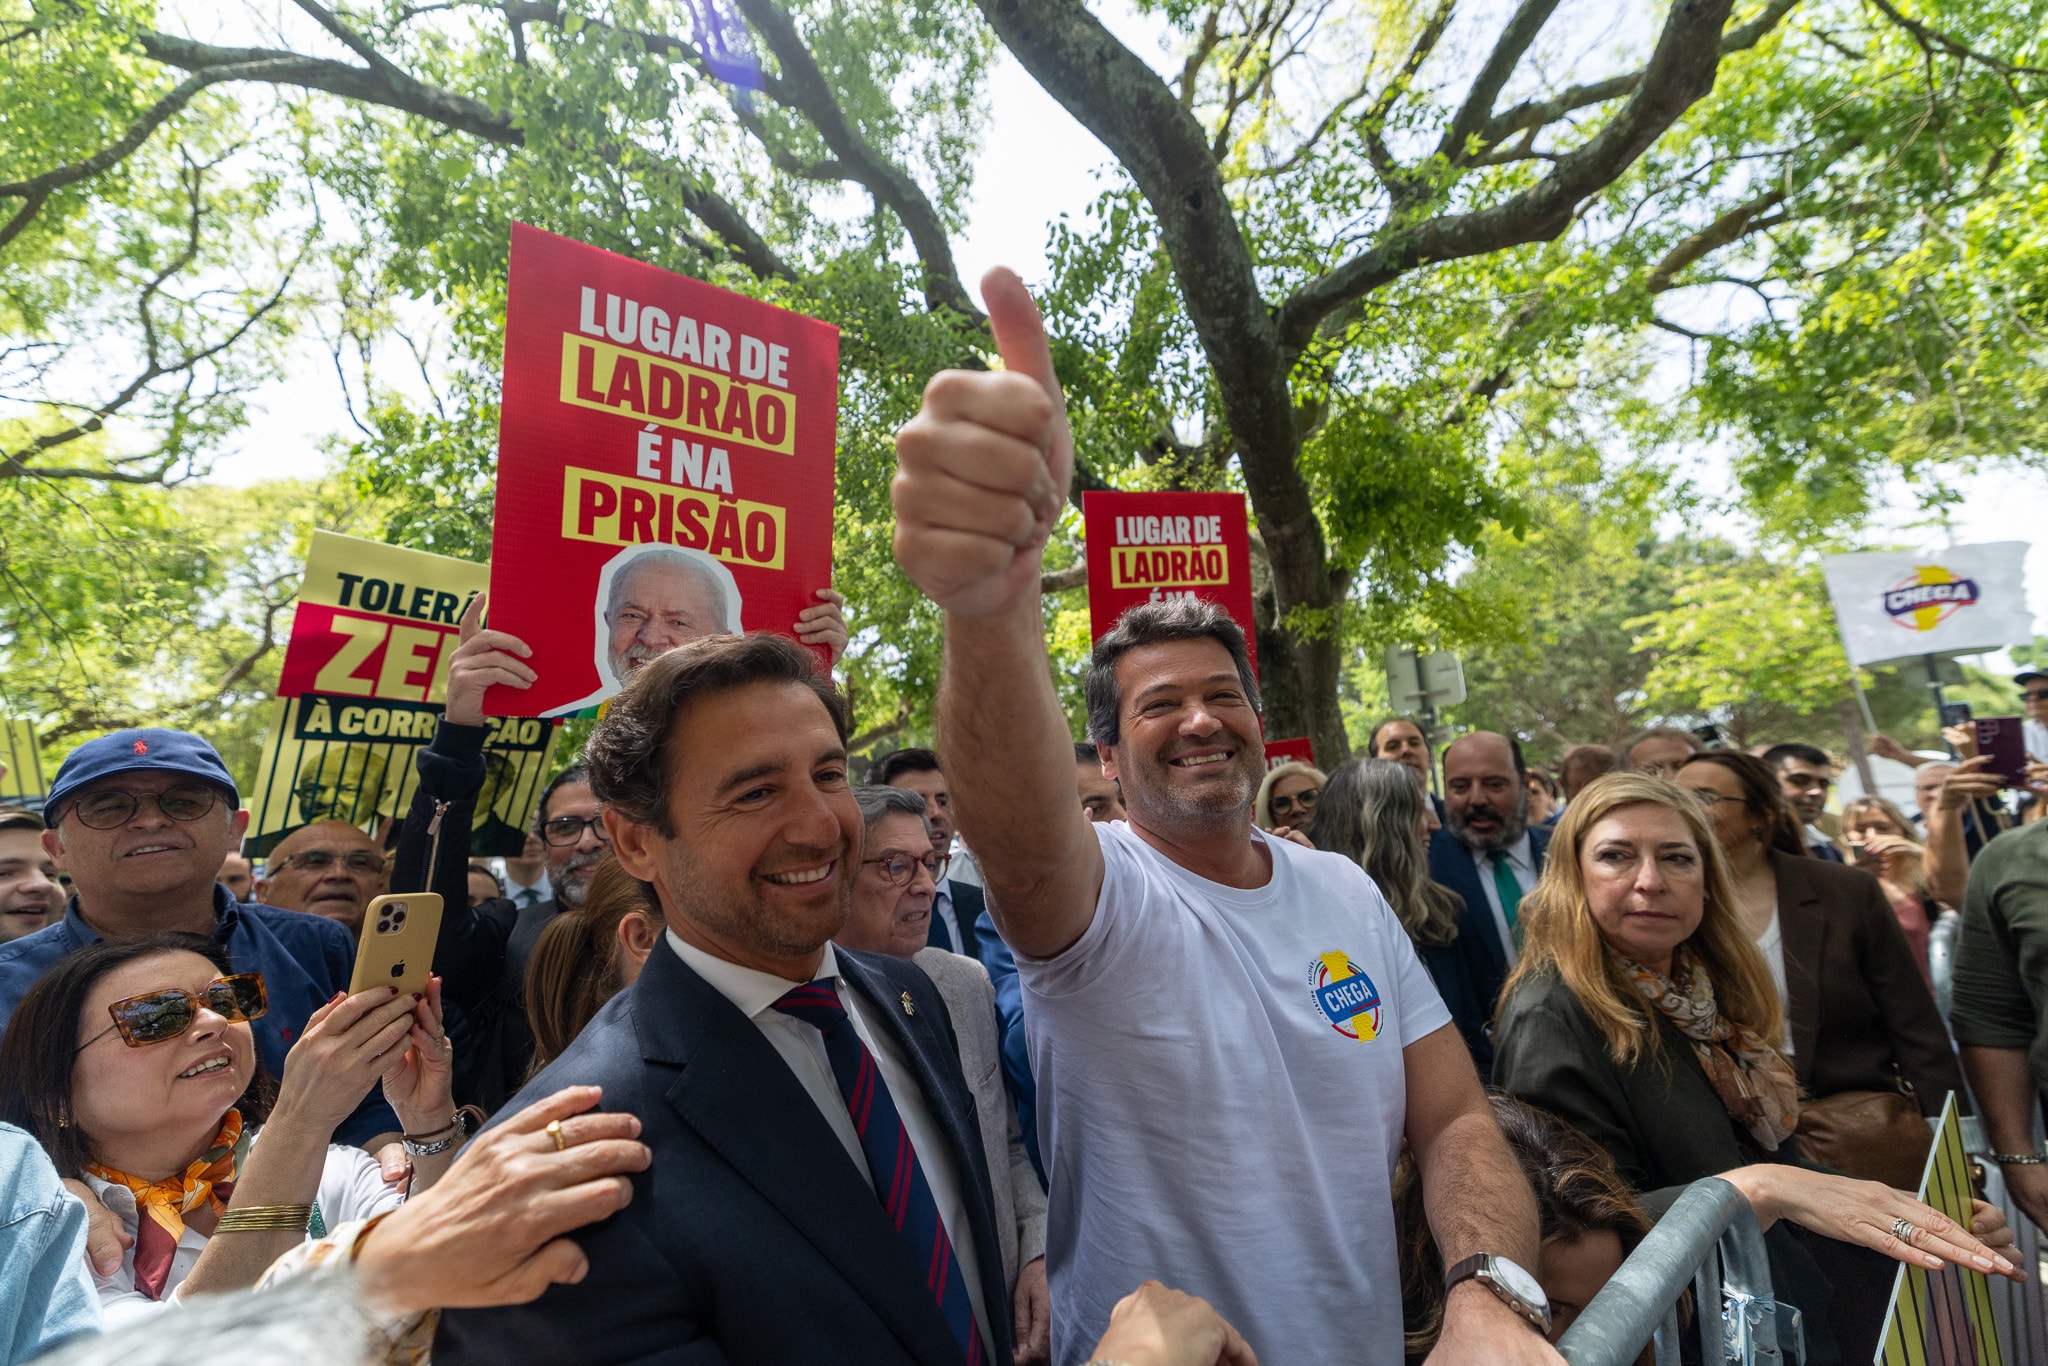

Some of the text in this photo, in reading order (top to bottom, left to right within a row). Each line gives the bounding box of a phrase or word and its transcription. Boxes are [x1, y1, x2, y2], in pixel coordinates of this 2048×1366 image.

[579, 285, 789, 388] LUGAR DE
[576, 343, 787, 446] LADRÃO
[636, 422, 734, 494] É NA
[577, 477, 777, 563] PRISÃO
[1115, 515, 1222, 545] LUGAR DE
[1118, 546, 1224, 584] LADRÃO
[1887, 583, 1972, 610] CHEGA
[303, 697, 332, 734] À
[1324, 979, 1373, 1012] CHEGA
